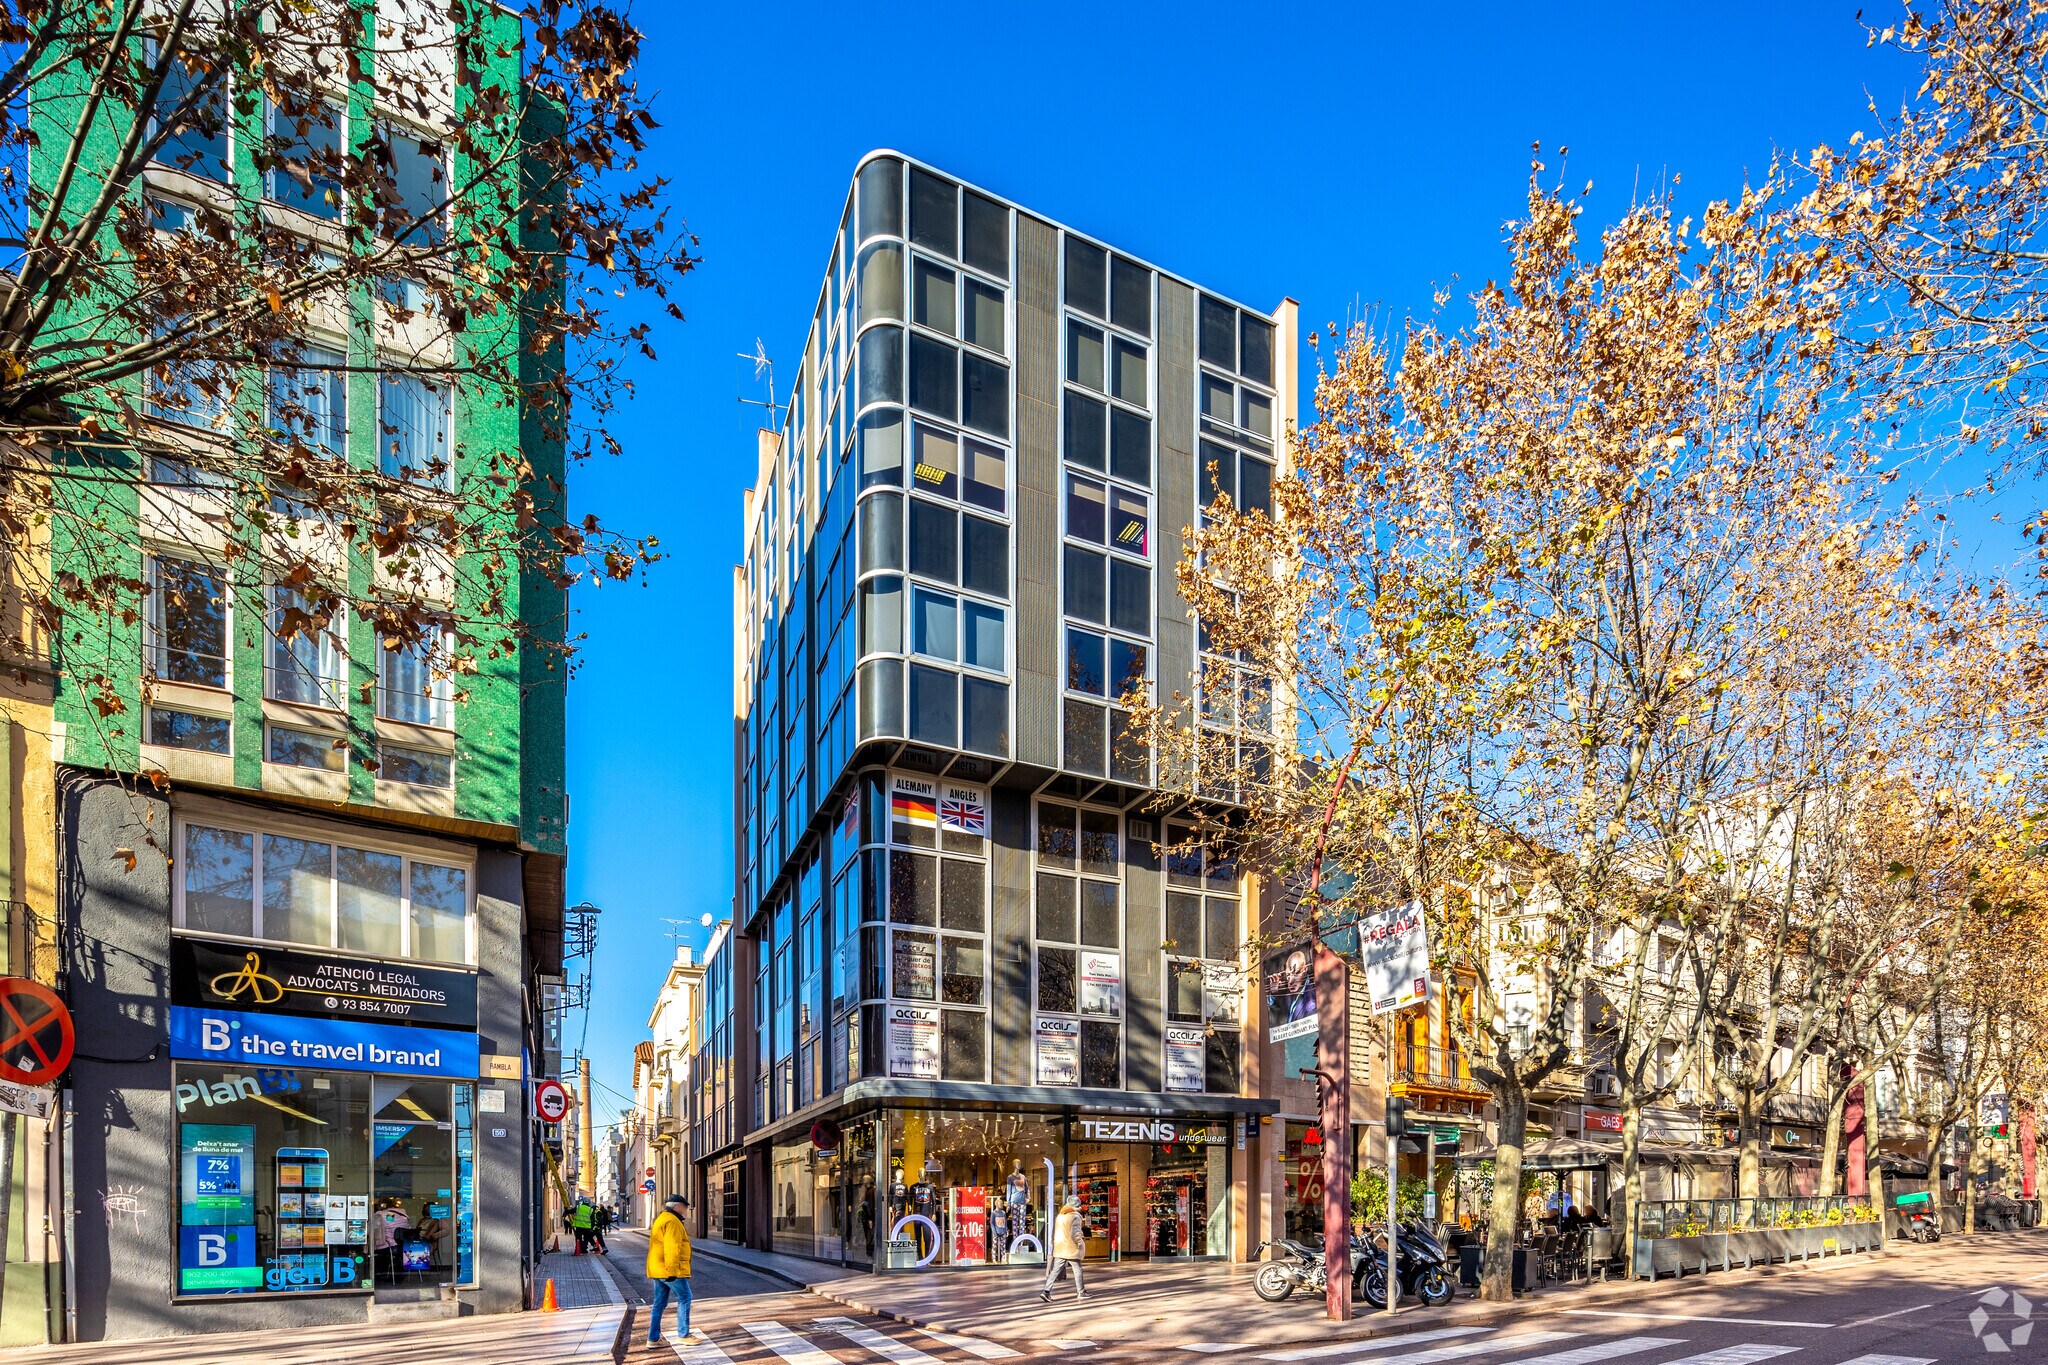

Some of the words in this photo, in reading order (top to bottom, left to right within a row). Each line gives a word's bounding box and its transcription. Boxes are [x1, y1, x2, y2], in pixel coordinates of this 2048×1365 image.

[896, 779, 932, 794] ALEMANY
[949, 788, 977, 802] ANGLÈS
[316, 965, 375, 981] ATENCIÓ
[378, 972, 420, 986] LEGAL
[287, 976, 359, 992] ADVOCATS
[370, 985, 446, 1001] MEDIADORS
[342, 999, 358, 1009] 93
[359, 1001, 381, 1012] 854
[383, 1003, 411, 1015] 7007
[202, 1018, 231, 1051] B
[241, 1035, 286, 1056] the
[290, 1039, 363, 1062] travel
[369, 1043, 440, 1067] brand
[489, 1062, 512, 1071] RAMBLA
[175, 1076, 262, 1113] Plan
[1600, 1115, 1620, 1129] GAES
[1179, 1134, 1226, 1143] underwear
[207, 1159, 230, 1171] 7%
[199, 1181, 217, 1190] 5%
[198, 1234, 227, 1266] B
[265, 1267, 326, 1291] gen
[333, 1257, 356, 1284] B
